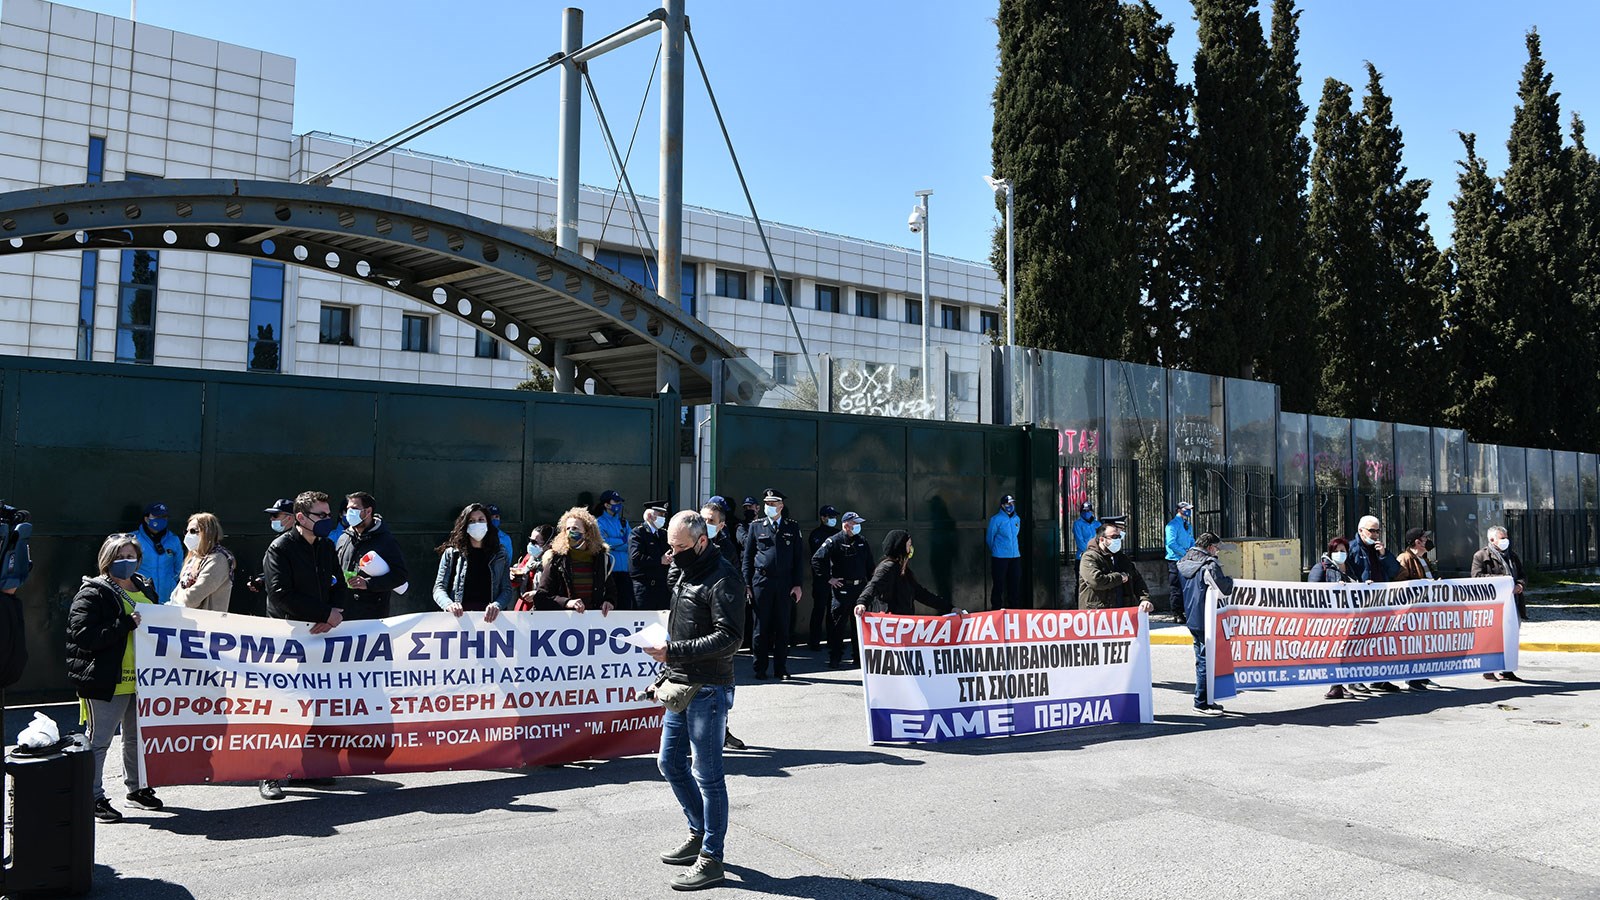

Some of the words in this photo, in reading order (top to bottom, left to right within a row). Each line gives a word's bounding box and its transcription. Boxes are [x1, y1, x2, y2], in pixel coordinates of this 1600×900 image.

[1258, 588, 1332, 608] ΑΝΑΛΓΗΣΙΑ!
[1333, 589, 1350, 609] ΤΑ
[1432, 584, 1449, 603] ΣΤΟ
[1452, 583, 1497, 602] ΚΟΚΚΙΝΟ
[864, 616, 951, 644] ΤΕΡΜΑ
[956, 614, 999, 643] ΠΙΑ
[1004, 613, 1020, 640] Η
[1026, 609, 1135, 639] ΚΟΡΟΪΔΙΑ
[1275, 617, 1303, 636] ΚΑΙ
[1303, 616, 1370, 637] ΥΠΟΥΡΓΕΙΟ
[1369, 616, 1387, 634] ΝΑ
[1385, 611, 1431, 633] ΠΑΡΟΥΝ
[1431, 610, 1461, 631] ΤΩΡΑ
[1463, 608, 1495, 629] ΜΕΤΡΑ
[147, 625, 307, 664] ΤΕΡΜΑ
[322, 633, 394, 663] ΠΙΑ
[408, 630, 515, 661] ΣΤΗΝ
[933, 642, 1100, 675] ΕΠΑΝΑΛΑΜΒΑΝΟΜΕΝΑ
[1102, 641, 1131, 665] ΤΕΣΤ
[1245, 640, 1272, 661] ΤΗΝ
[1274, 639, 1330, 660] ΑΣΦΑΛΗ
[1328, 635, 1398, 659] ΛΕΙΤΟΥΡΓΙΑ
[1399, 634, 1423, 655] ΤΩΝ
[1425, 632, 1475, 654] ΣΧΟΛΕΙΩΝ
[137, 668, 237, 688] ΚΡΑΤΙΚΗ
[245, 671, 331, 689] ΕΥΘΥΝΗ
[338, 672, 352, 689] Η
[357, 669, 436, 688] ΥΓΙΕΙΝΗ
[443, 668, 475, 685] ΚΑΙ
[482, 667, 494, 684] Η
[500, 664, 596, 684] ΑΣΦΑΛΕΙΑ
[600, 662, 633, 679] ΣΤΑ
[1268, 670, 1290, 683] Π.Ε.
[1298, 668, 1328, 681] ΕΛΜΕ
[1335, 662, 1410, 679] ΠΡΩΤΟΒΟΥΛΙΑ
[1411, 658, 1481, 674] ΑΝΑΠΛΗΡΩΤΩΝ
[138, 696, 273, 718] ΜΟΡΦΩΣΗ
[297, 698, 369, 717] ΥΓΕΙΑ
[390, 693, 496, 714] ΣΤΑΘΕΡΗ
[502, 688, 600, 710] ΔΟΥΛΕΙΑ
[605, 686, 638, 703] ΓΙΑ
[957, 676, 987, 703] ΣΤΑ
[988, 672, 1049, 700] ΣΧΟΛΕΙΑ
[890, 707, 1016, 739] ΕΛΜΕ
[1034, 699, 1113, 729] ΠΕΙΡΑΙΑ
[229, 733, 386, 751] ΕΚΠΑΙΔΕΥΤΙΚΩΝ
[391, 732, 423, 748] Π.Ε.
[428, 729, 481, 745] "ΡΟΖΑ
[485, 722, 570, 742] ΙΜΒΡΙΩΤΗ"
[584, 720, 607, 735] "Μ.
